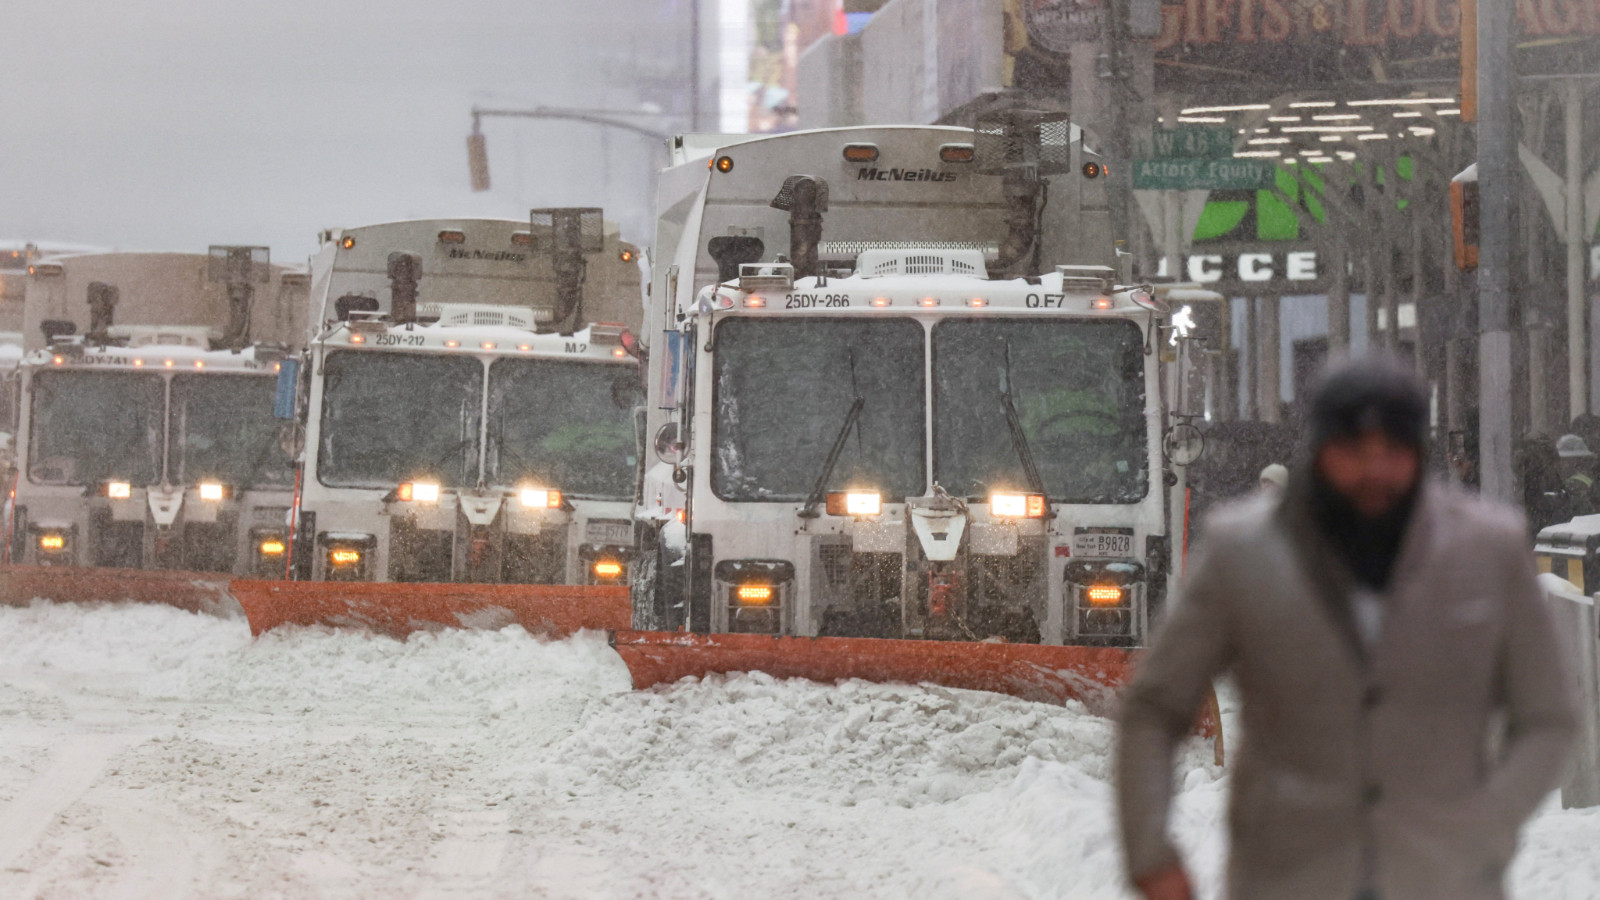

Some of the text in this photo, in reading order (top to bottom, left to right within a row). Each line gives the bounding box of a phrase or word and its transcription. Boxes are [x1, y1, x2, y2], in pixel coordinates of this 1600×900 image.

[1311, 4, 1332, 31] &
[1156, 132, 1174, 155] W
[858, 168, 958, 182] McNeilus
[1208, 162, 1263, 183] Equity
[785, 294, 850, 309] 25DY-266
[376, 334, 425, 347] 25DY-212
[1105, 536, 1130, 552] 9828
